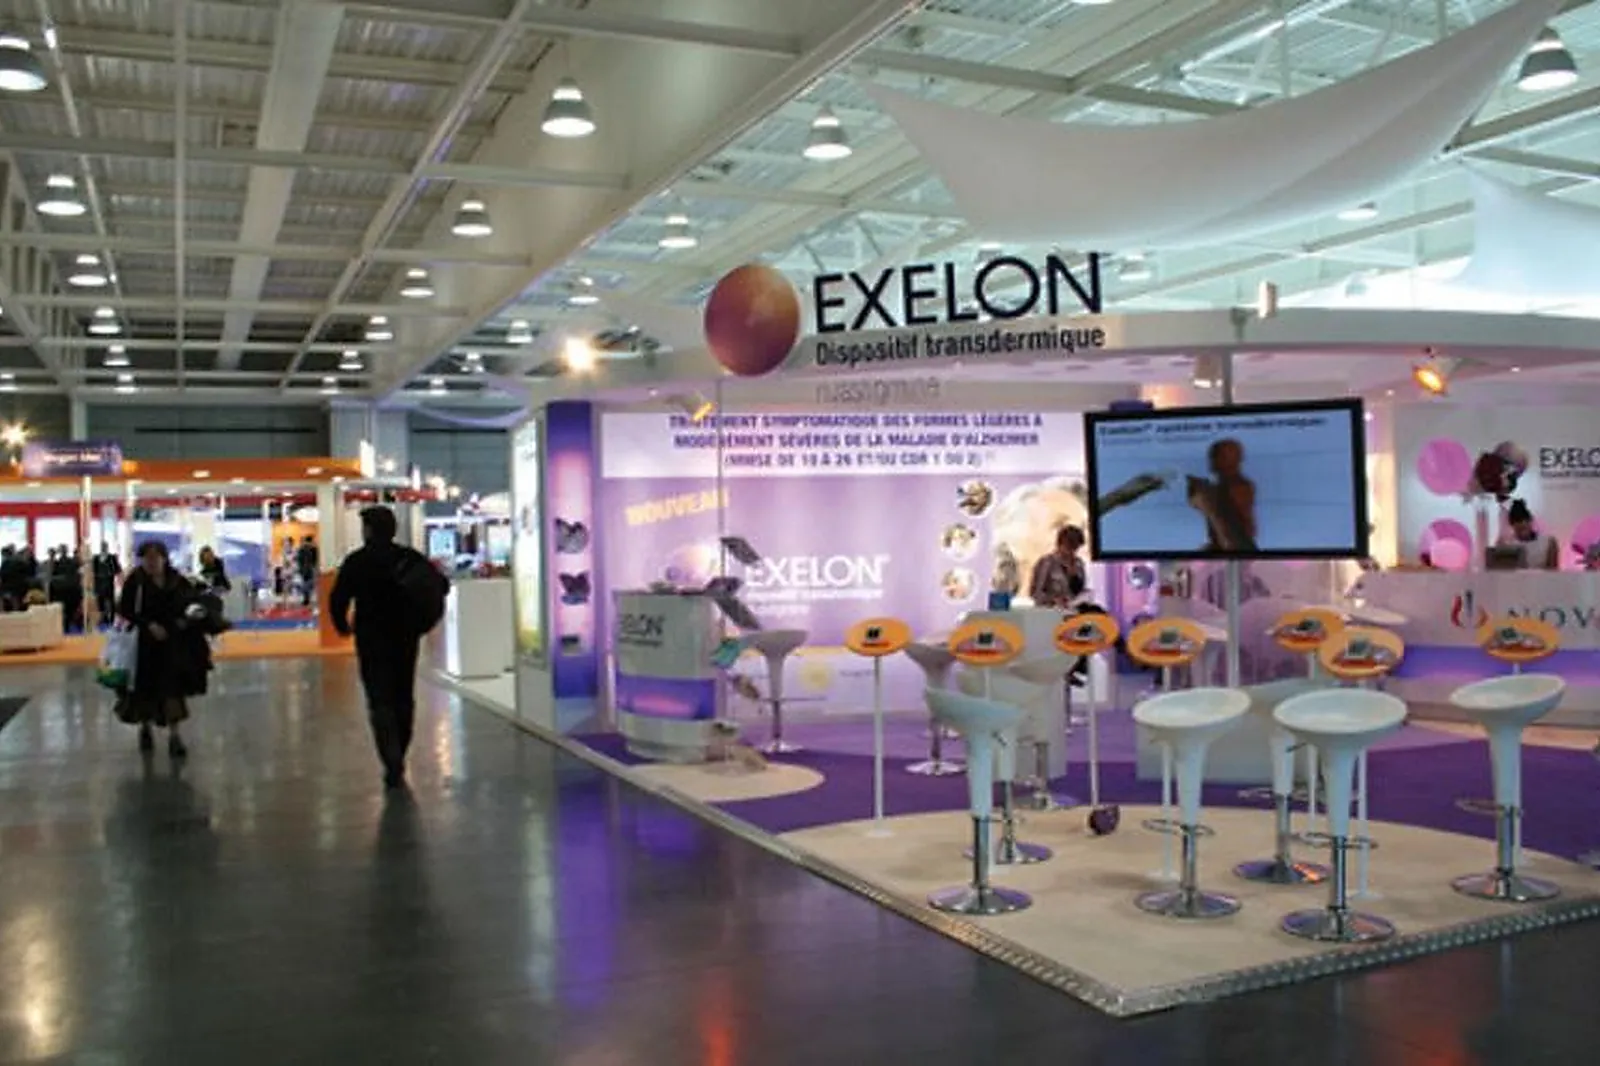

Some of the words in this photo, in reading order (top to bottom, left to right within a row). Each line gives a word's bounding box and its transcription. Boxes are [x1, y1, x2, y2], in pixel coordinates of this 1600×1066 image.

[813, 252, 1101, 333] EXELON
[815, 332, 918, 368] Dispositif
[926, 321, 1106, 357] transdermique
[883, 414, 911, 427] DES
[845, 433, 862, 447] DE
